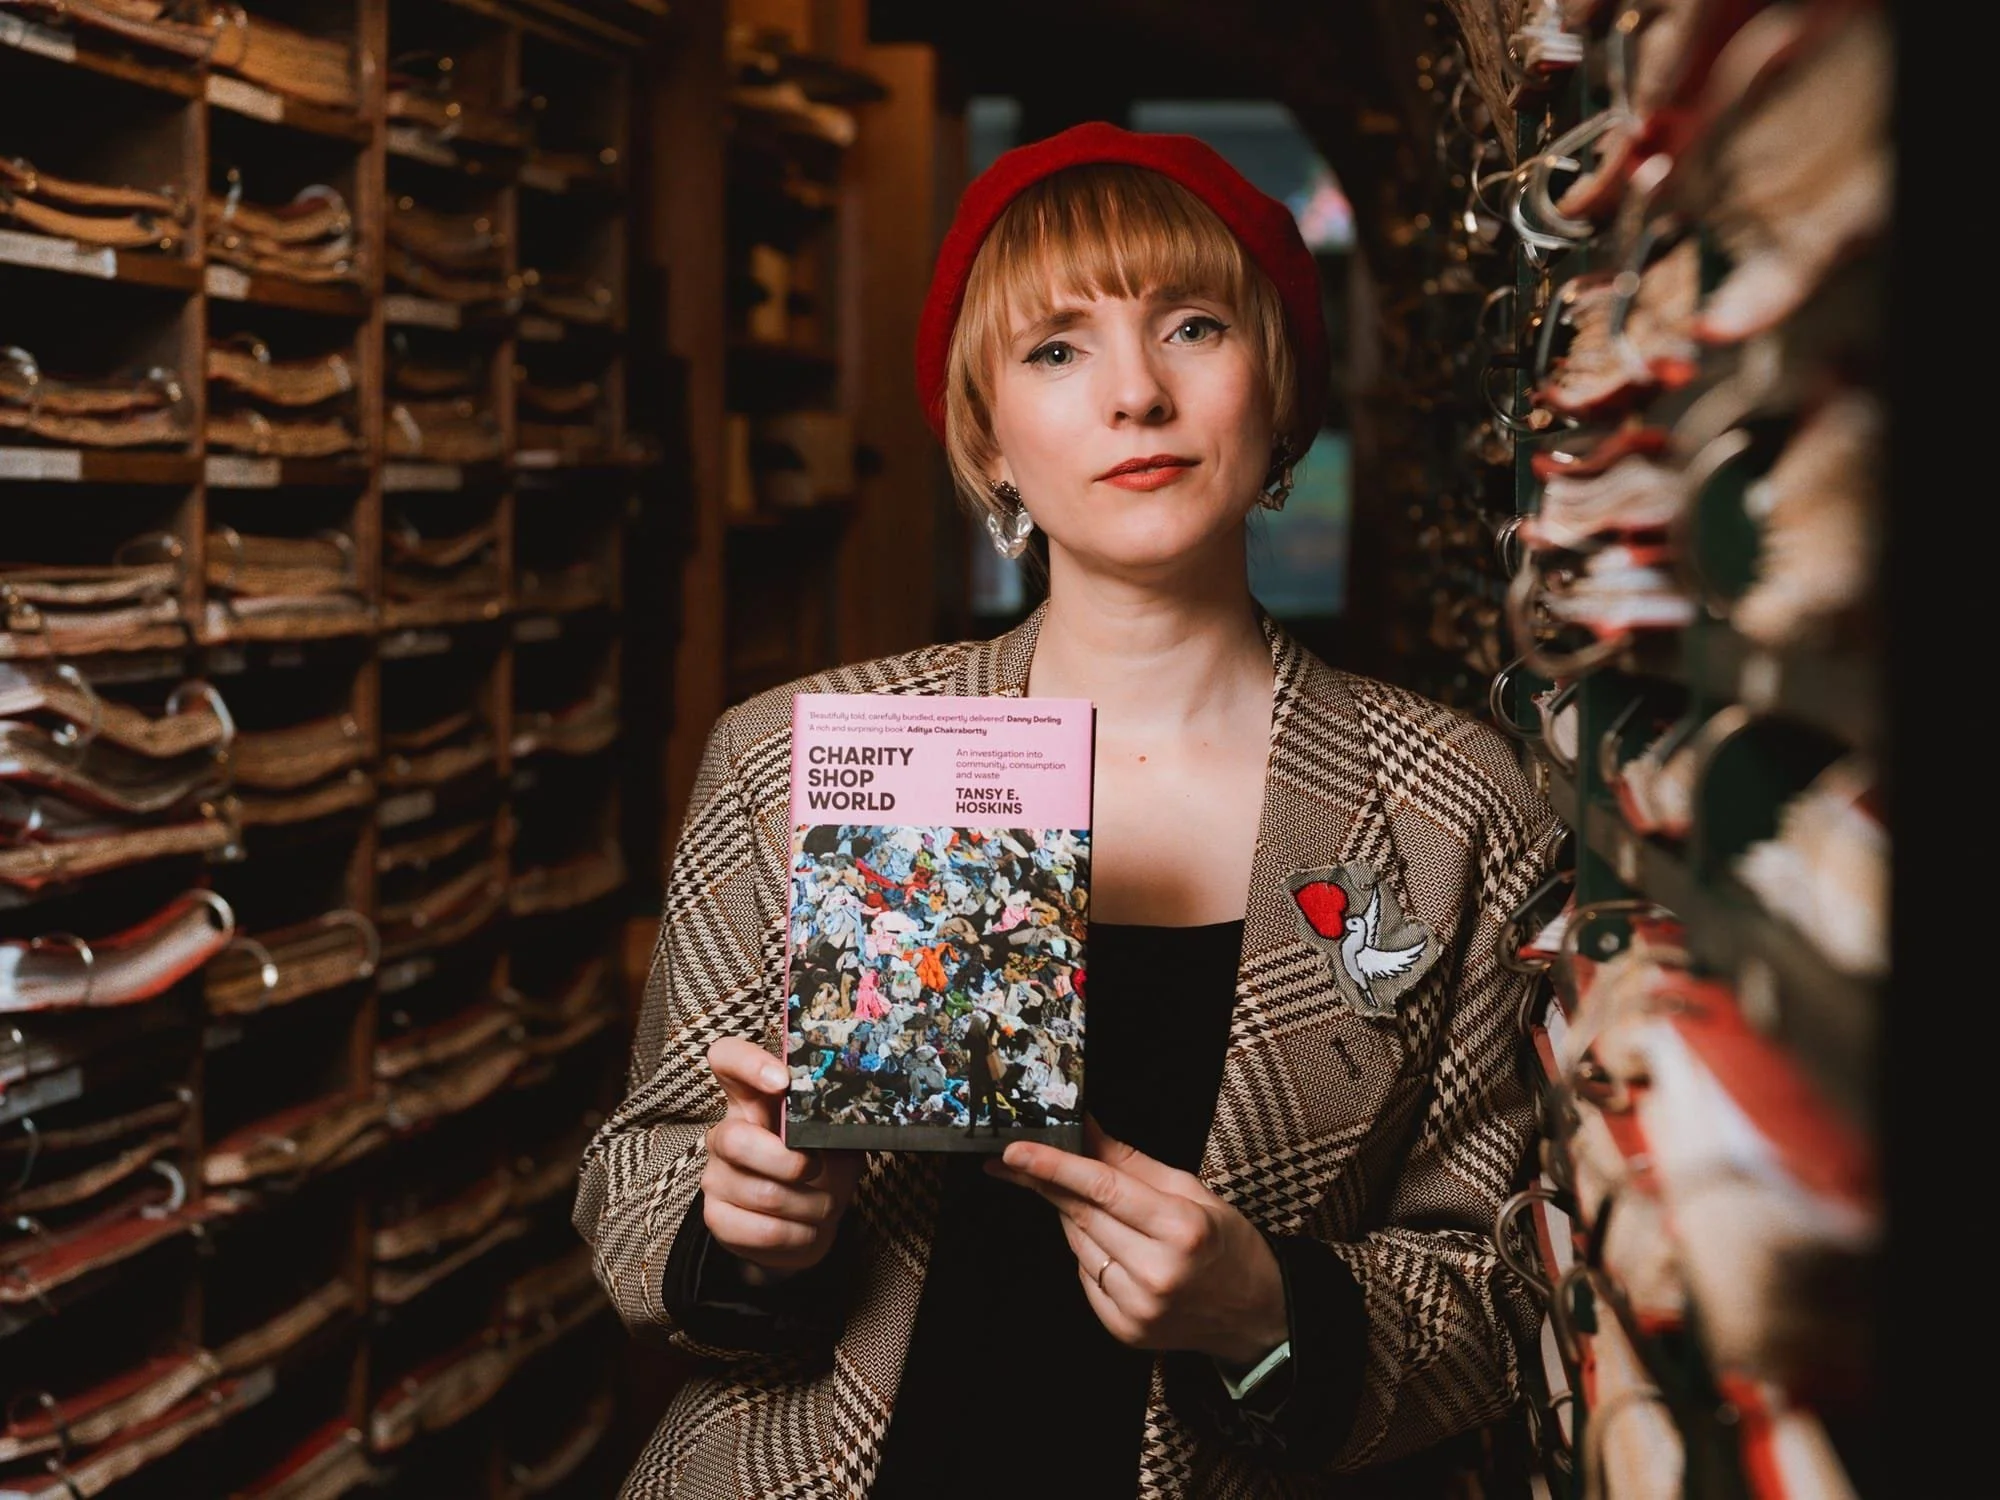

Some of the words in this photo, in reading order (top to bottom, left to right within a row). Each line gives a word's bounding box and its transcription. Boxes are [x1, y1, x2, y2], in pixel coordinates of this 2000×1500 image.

[850, 712, 866, 720] told,
[868, 712, 901, 722] carefully
[902, 713, 935, 721] bundled,
[936, 714, 968, 723] expertly
[1007, 715, 1032, 724] Danny
[1033, 715, 1062, 725] Dorling
[816, 724, 830, 732] rich
[831, 724, 846, 732] and
[847, 725, 883, 735] surprising
[907, 726, 933, 735] Aditya
[934, 726, 987, 736] Chakrabortty
[808, 746, 914, 766] CHARITY
[956, 749, 968, 758] An
[970, 749, 1024, 759] investigation
[1026, 750, 1043, 758] into
[956, 761, 1007, 771] community,
[1009, 762, 1066, 771] consumption
[808, 768, 875, 788] SHOP
[956, 771, 972, 779] and
[974, 771, 1000, 780] waste
[808, 791, 896, 811] WORLD
[955, 788, 1003, 800] TANSY
[1006, 789, 1020, 801] E.
[955, 801, 1023, 815] HOSKINS
